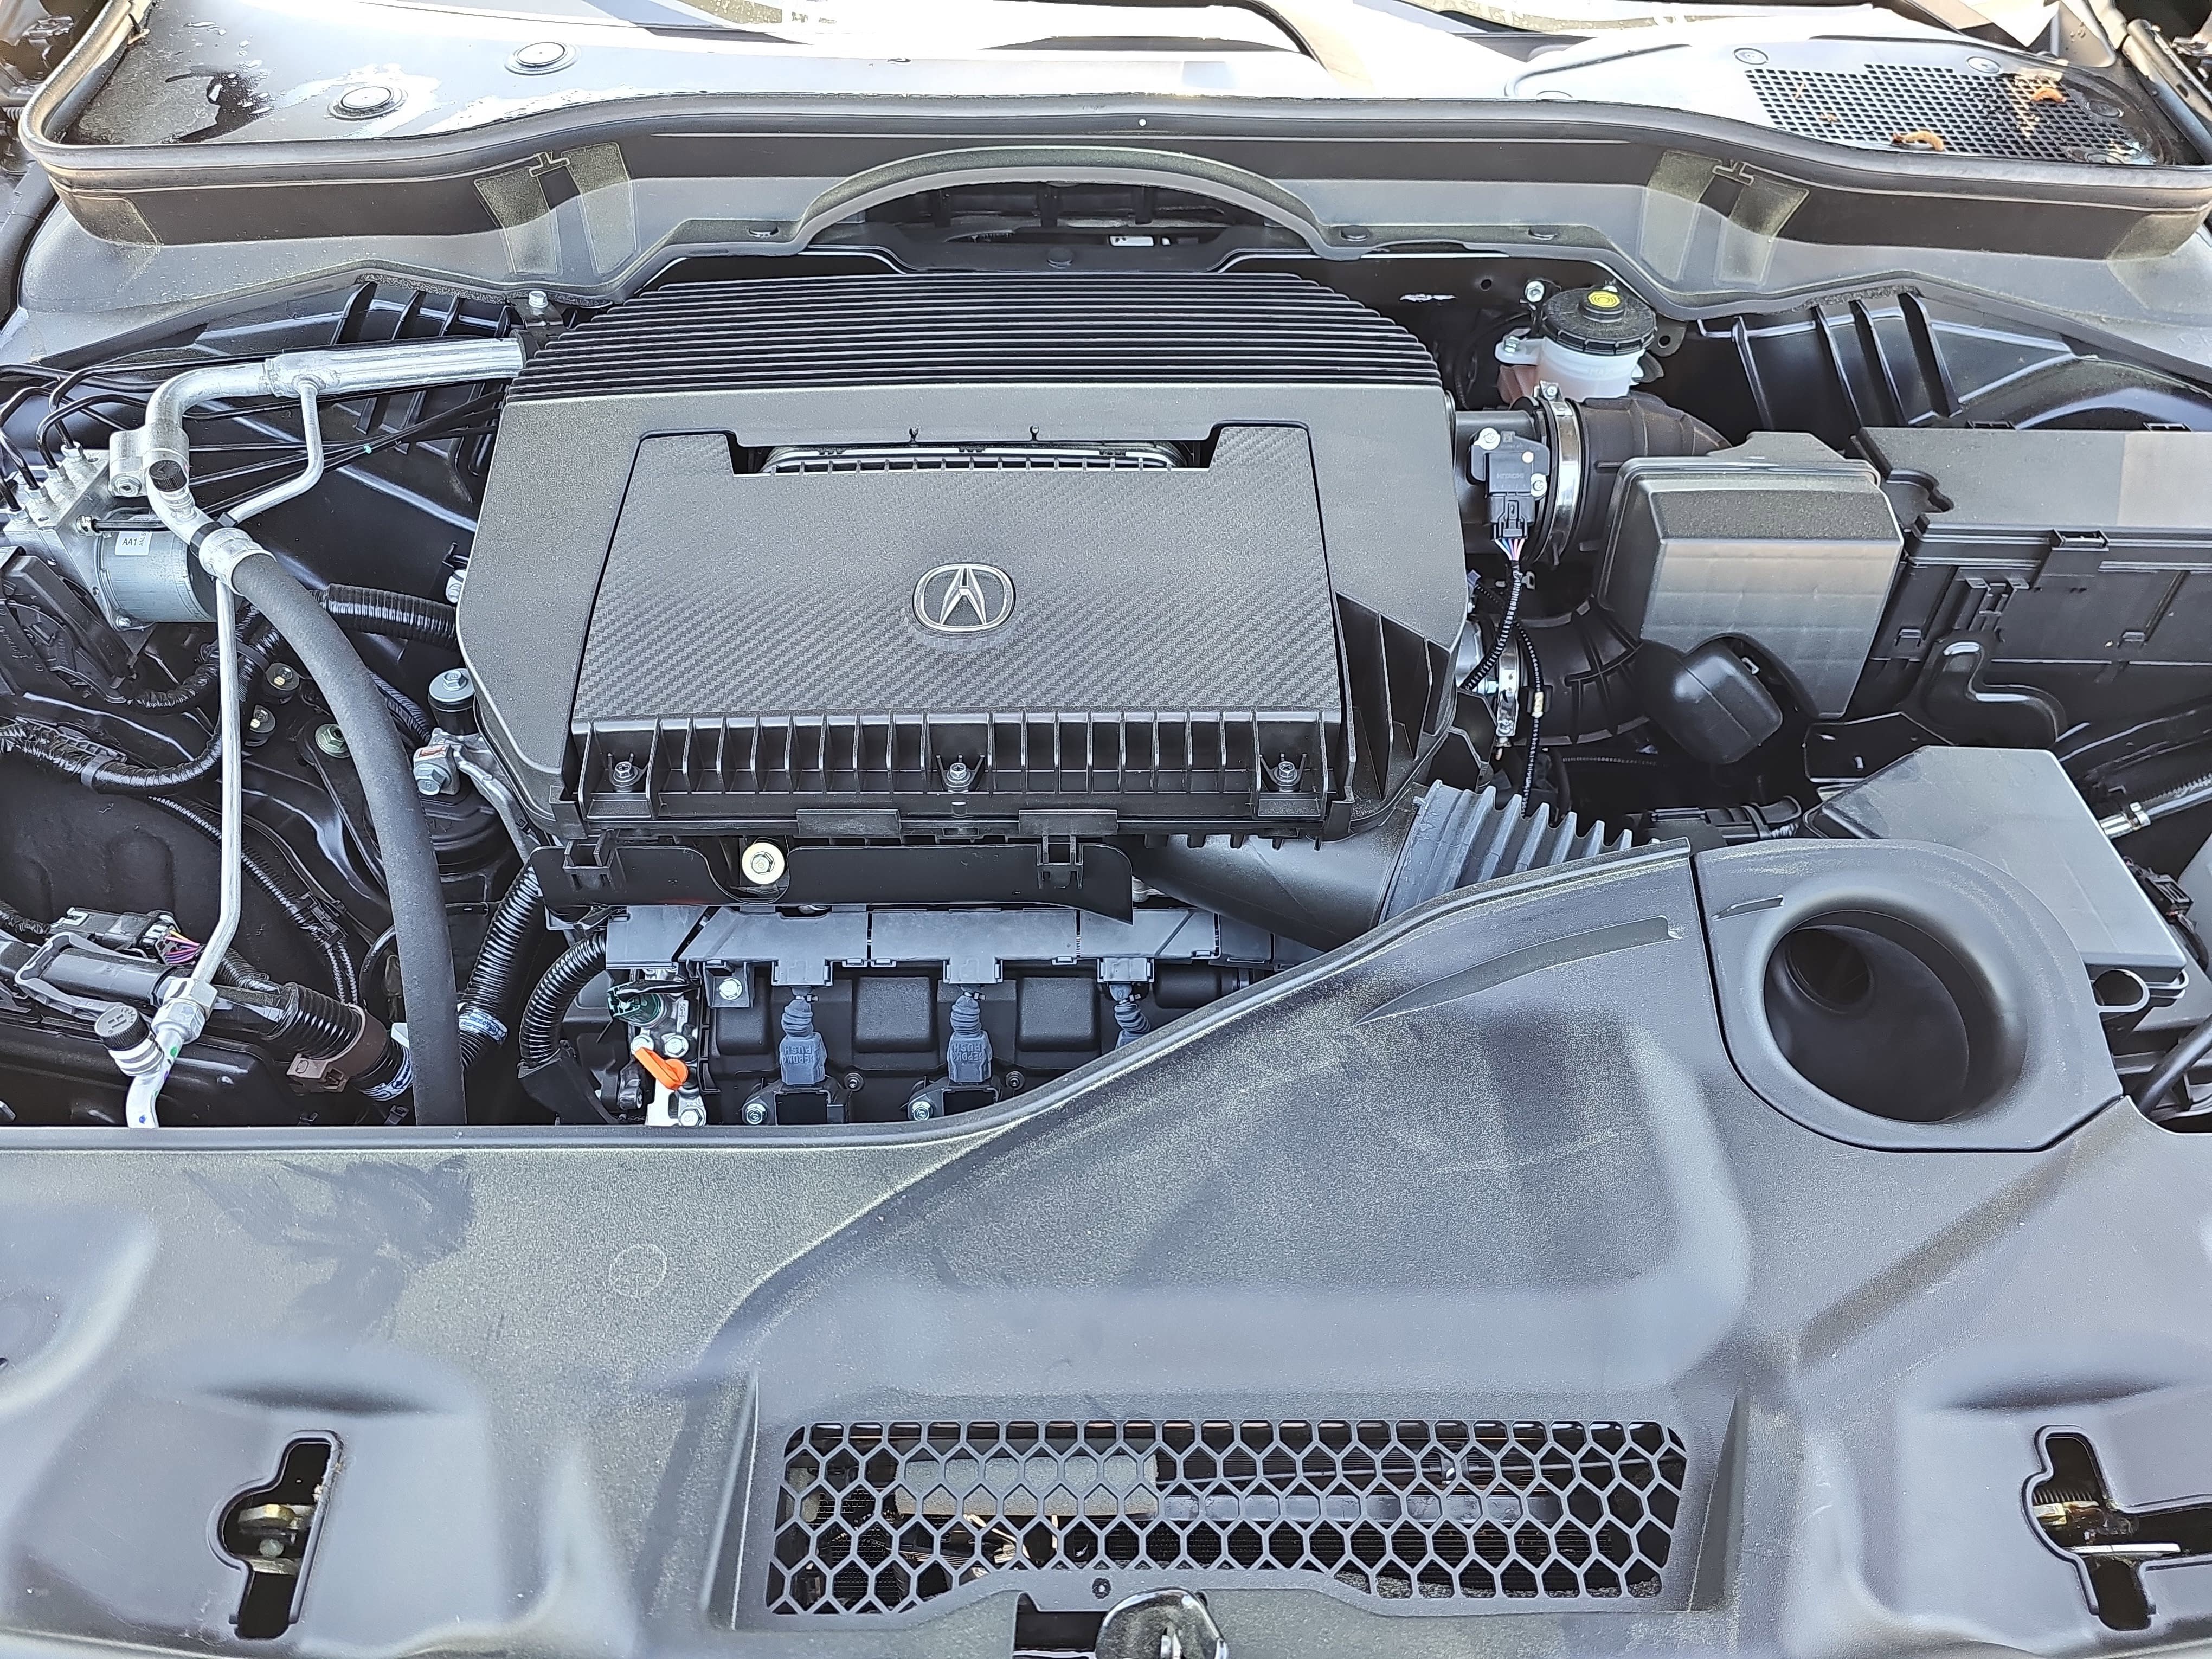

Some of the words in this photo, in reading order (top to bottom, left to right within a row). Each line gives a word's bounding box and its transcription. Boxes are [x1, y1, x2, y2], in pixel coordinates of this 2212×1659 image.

[121, 538, 137, 546] AA1
[784, 1045, 812, 1054] PUSH
[954, 1043, 981, 1052] PUSH
